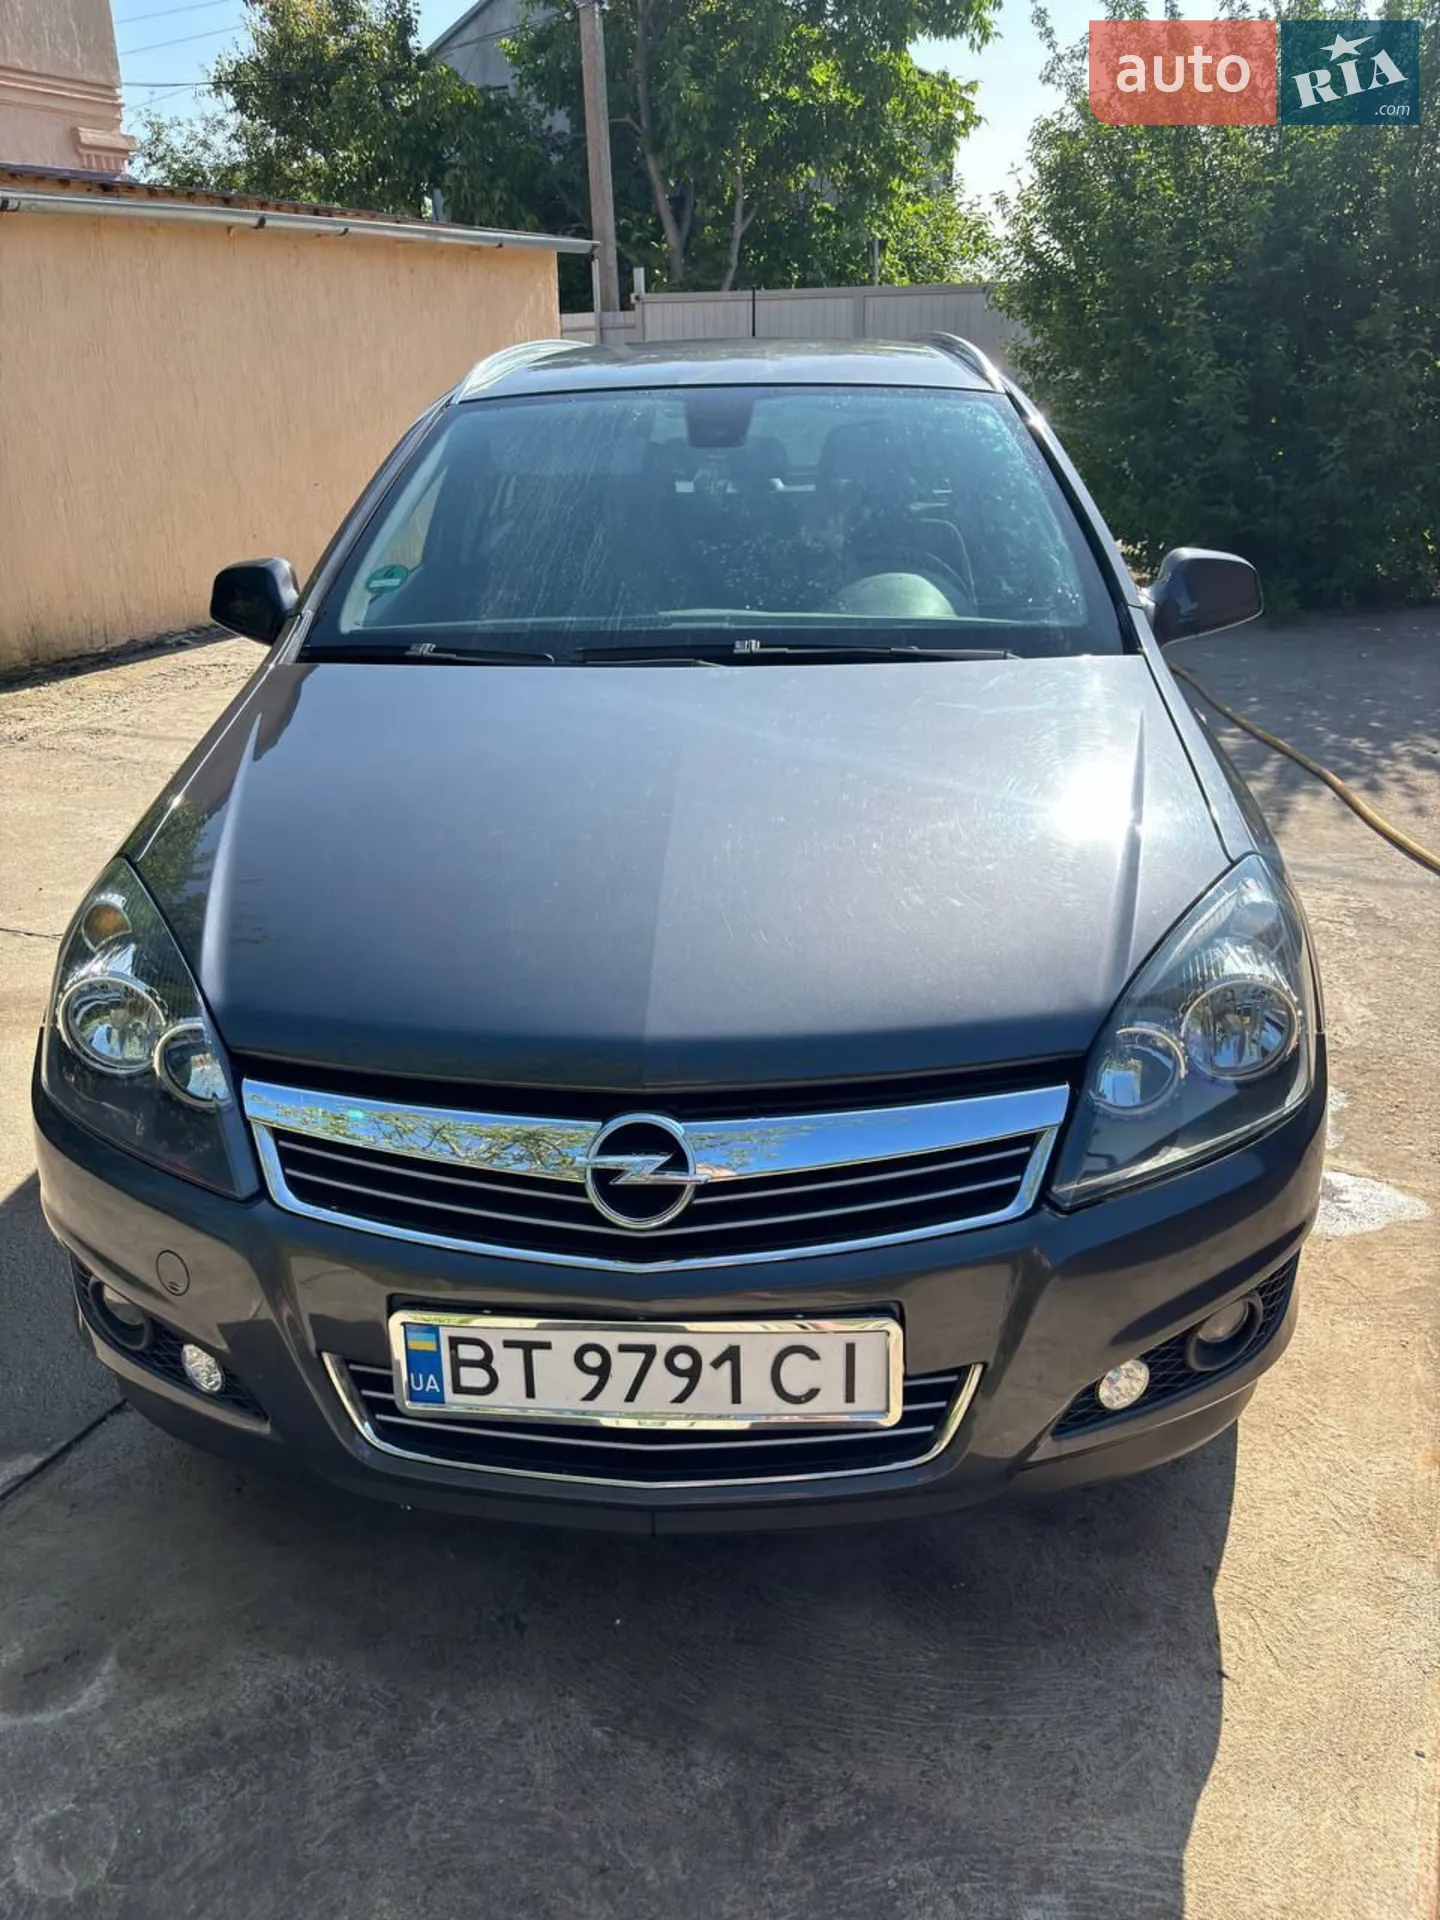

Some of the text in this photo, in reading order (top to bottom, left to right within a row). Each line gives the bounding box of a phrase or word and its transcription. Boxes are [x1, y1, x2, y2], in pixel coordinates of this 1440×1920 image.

[410, 1372, 440, 1393] UA
[448, 1336, 856, 1405] BT 9791 CI
